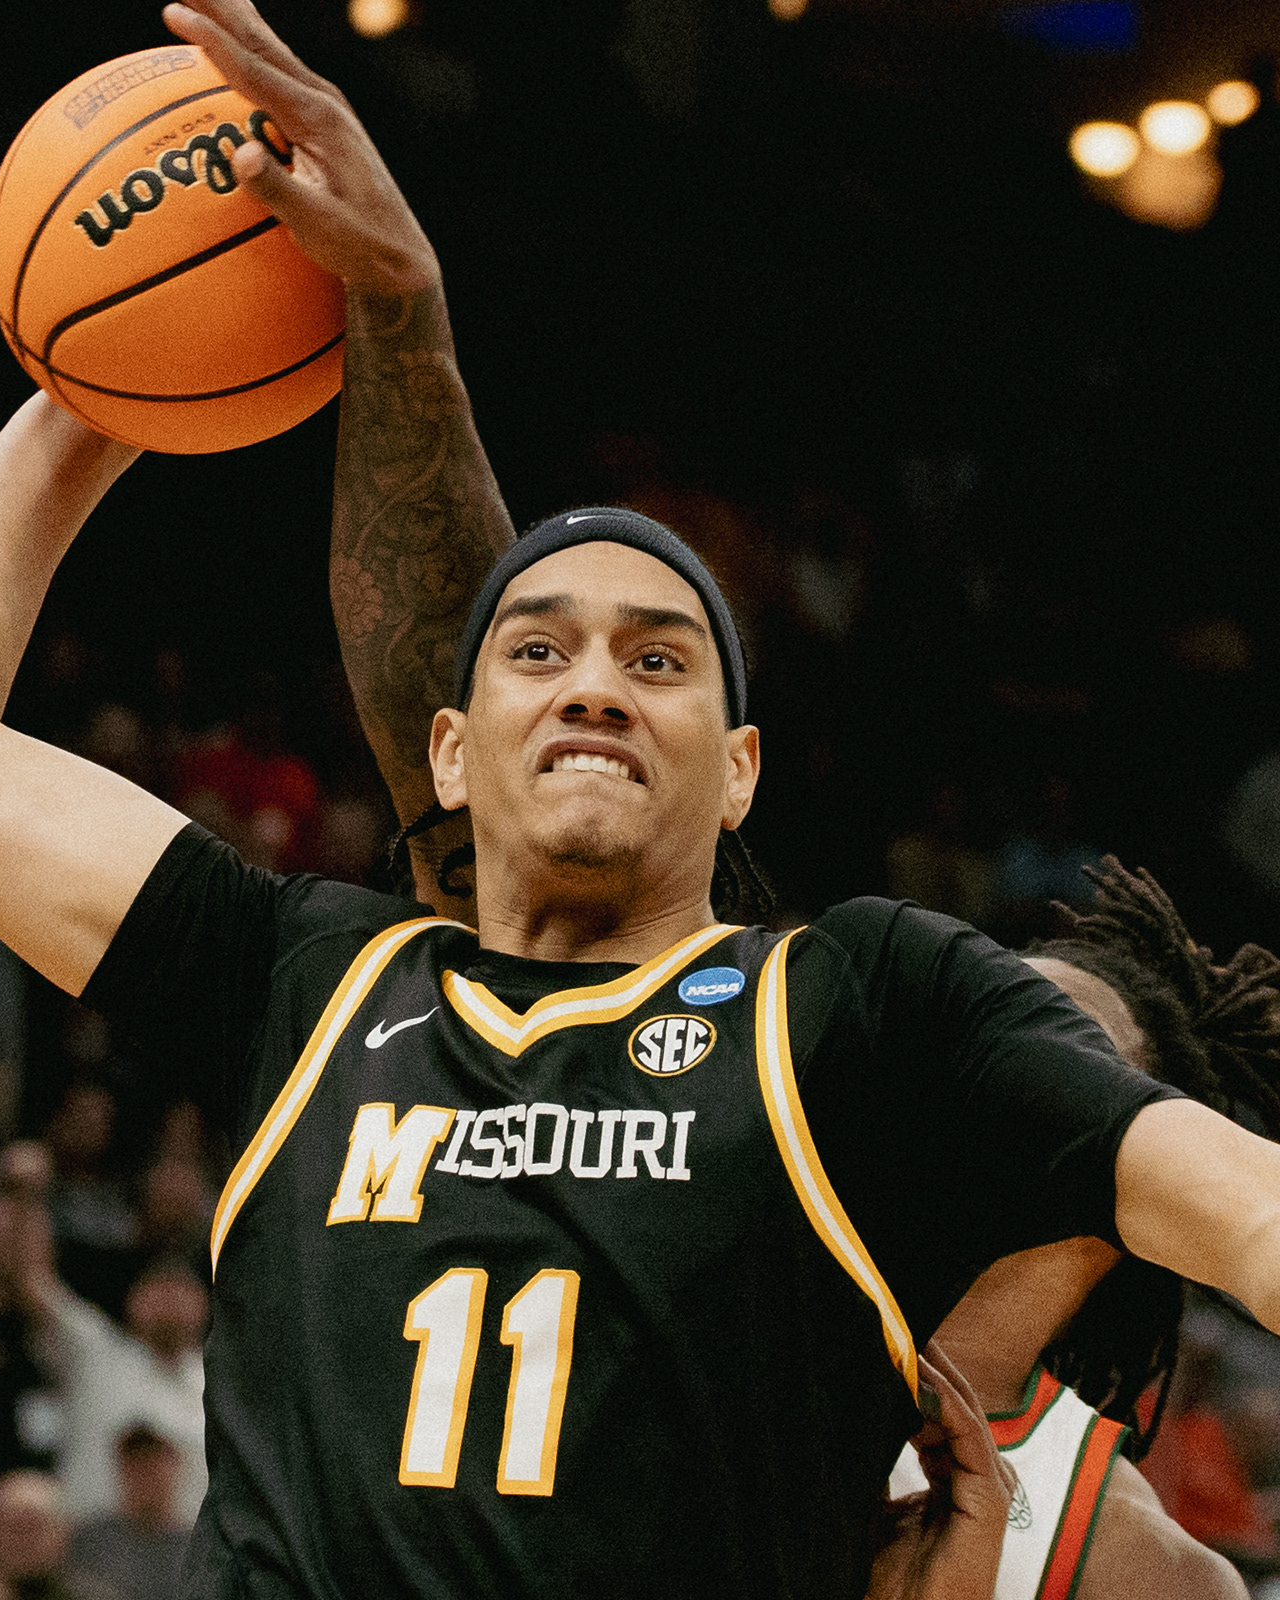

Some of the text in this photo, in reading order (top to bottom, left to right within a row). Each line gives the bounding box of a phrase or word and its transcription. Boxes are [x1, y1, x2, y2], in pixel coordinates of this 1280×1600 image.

[685, 982, 740, 997] NCAA
[637, 1018, 708, 1072] SEC
[326, 1102, 696, 1226] MISSOURI
[398, 1267, 581, 1497] 11
